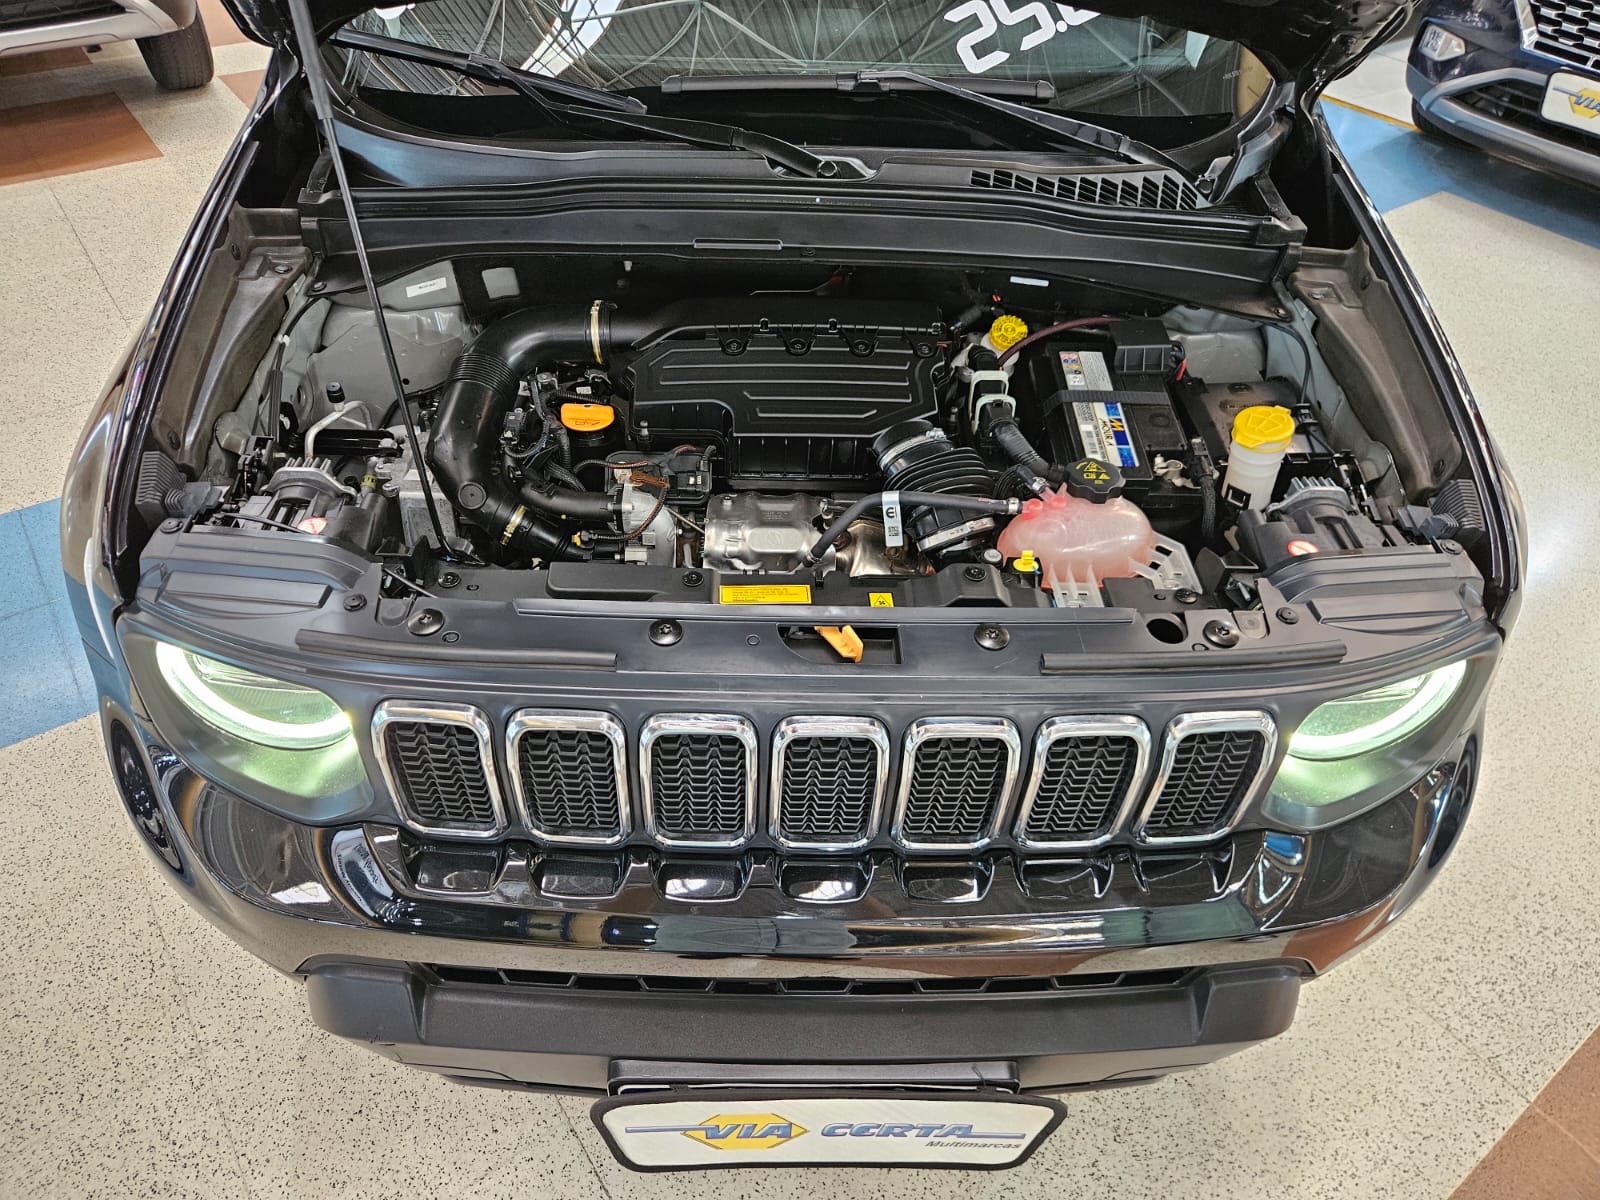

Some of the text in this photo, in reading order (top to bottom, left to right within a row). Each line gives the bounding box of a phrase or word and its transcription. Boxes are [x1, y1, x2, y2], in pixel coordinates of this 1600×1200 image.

[705, 1122, 974, 1139] VIA CERTA
[925, 1140, 1022, 1150] Multimarcas
